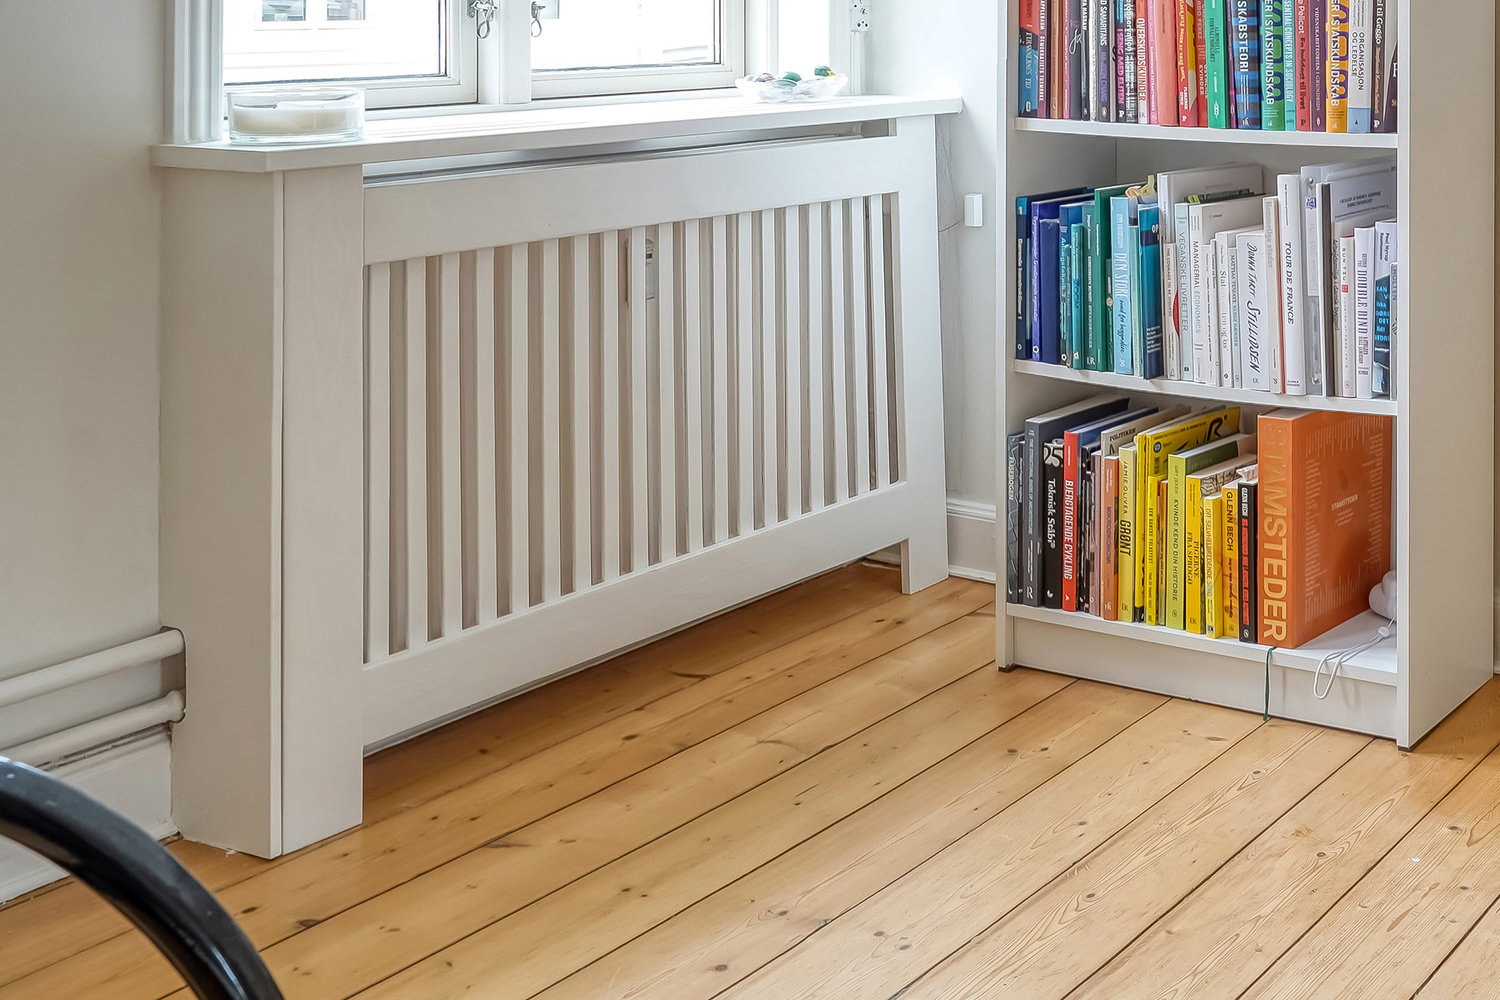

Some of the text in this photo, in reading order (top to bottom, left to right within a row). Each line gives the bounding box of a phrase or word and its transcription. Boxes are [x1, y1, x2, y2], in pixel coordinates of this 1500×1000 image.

[1100, 6, 1108, 46] SAMARITANS
[1297, 5, 1305, 34] Pelicot
[1376, 7, 1384, 17] til
[1284, 27, 1293, 59] CONCEPTS
[1351, 31, 1358, 44] OG
[1136, 17, 1146, 102] OVERSKUDSKVINDER
[1264, 19, 1275, 105] STATSKUNDSKAB
[1330, 19, 1341, 106] STATSKUNDSKAB
[1356, 31, 1365, 91] ORGANISASJON
[1117, 77, 1125, 105] ELITEN
[1299, 91, 1307, 110] livet
[1113, 252, 1128, 273] DEN
[1178, 232, 1188, 331] VEGANSKE LIVRETTER
[1192, 240, 1200, 289] MANAGERIAL
[1246, 242, 1258, 298] DONNA TARTT
[1286, 270, 1293, 284] DE
[1114, 274, 1129, 298] STORE
[1357, 270, 1368, 334] DOUBLE BIND
[1246, 300, 1261, 374] STILLIDSEN
[1110, 428, 1136, 442] POLITIKEN
[1047, 478, 1056, 516] Teknisk
[1064, 479, 1074, 580] BJERGTAGENDE CYKLING
[1119, 519, 1131, 557] GRØNT
[1226, 491, 1234, 551] GLENN BECH
[1263, 424, 1288, 641] STAMSTEDER
